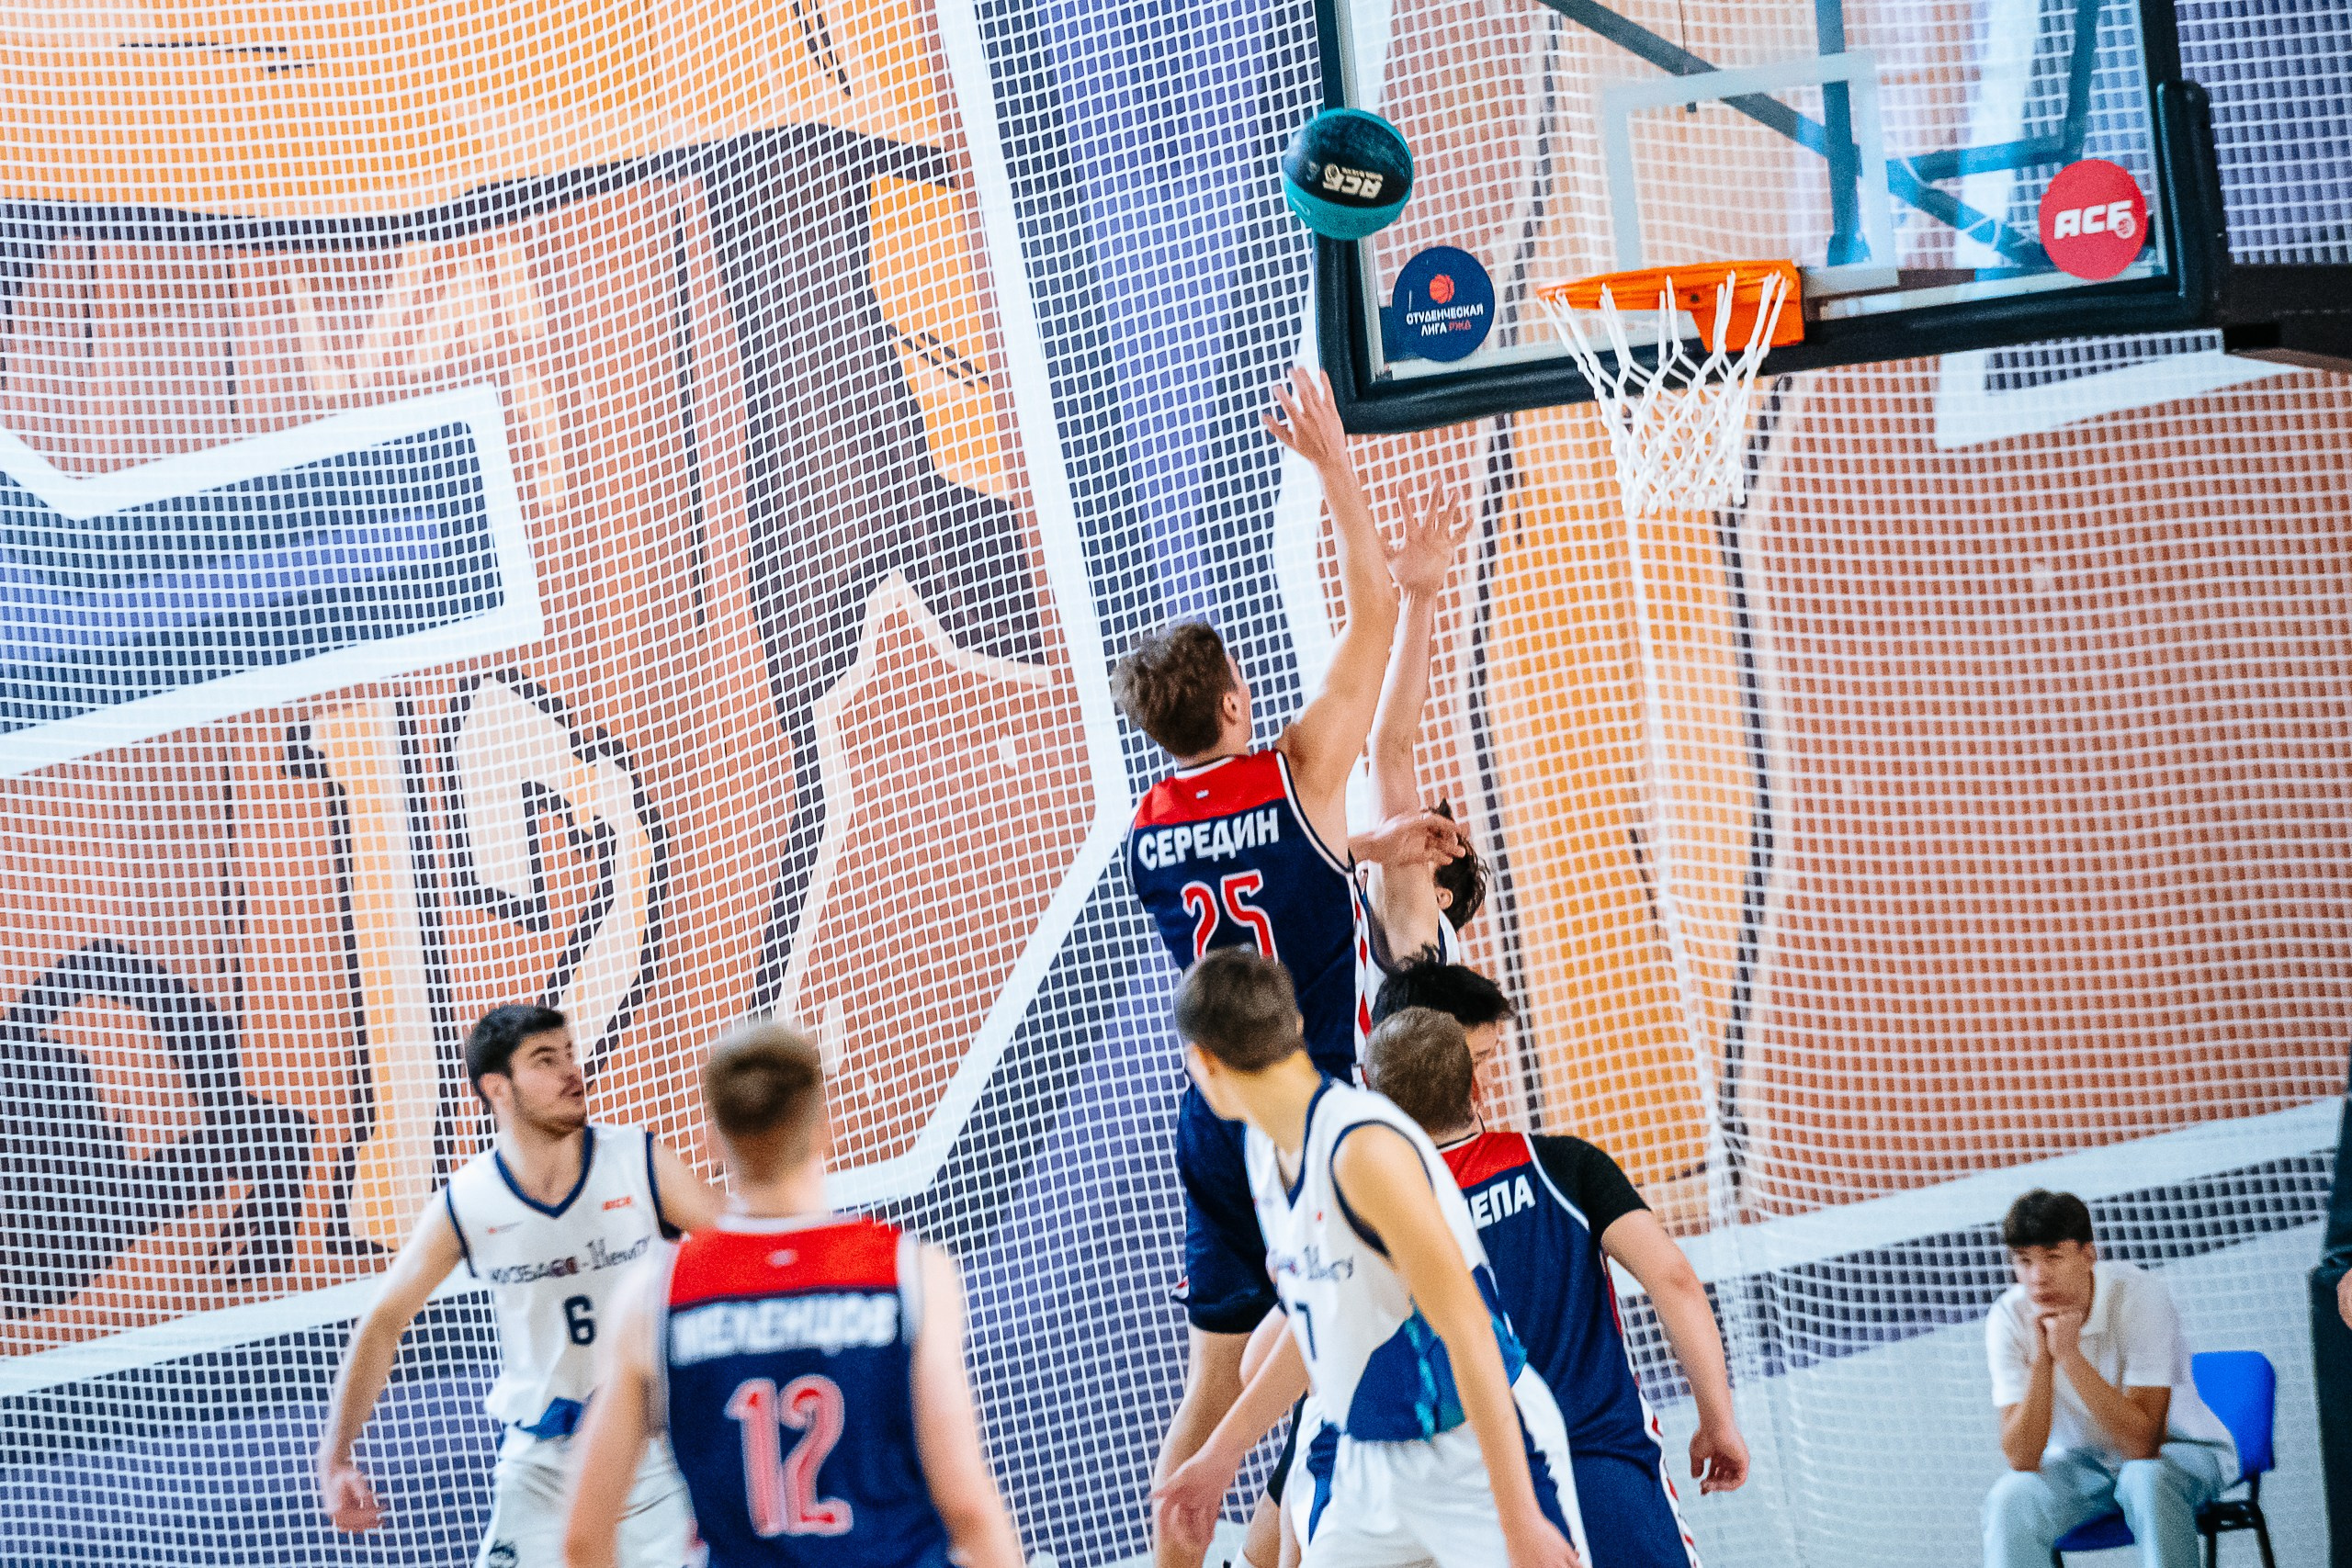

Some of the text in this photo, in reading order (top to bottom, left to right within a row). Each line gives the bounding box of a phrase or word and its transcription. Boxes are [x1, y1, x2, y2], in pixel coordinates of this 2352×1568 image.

[2053, 199, 2136, 241] АСБ
[1406, 303, 1484, 326] СТУДЕНЧЕСКАЯ
[1421, 321, 1447, 337] ЛИГА
[1137, 807, 1280, 871] СЕРЕДИН
[1180, 868, 1280, 965] 25
[1468, 1174, 1536, 1231] ЕПА
[562, 1294, 597, 1347] 6
[723, 1373, 854, 1540] 12
